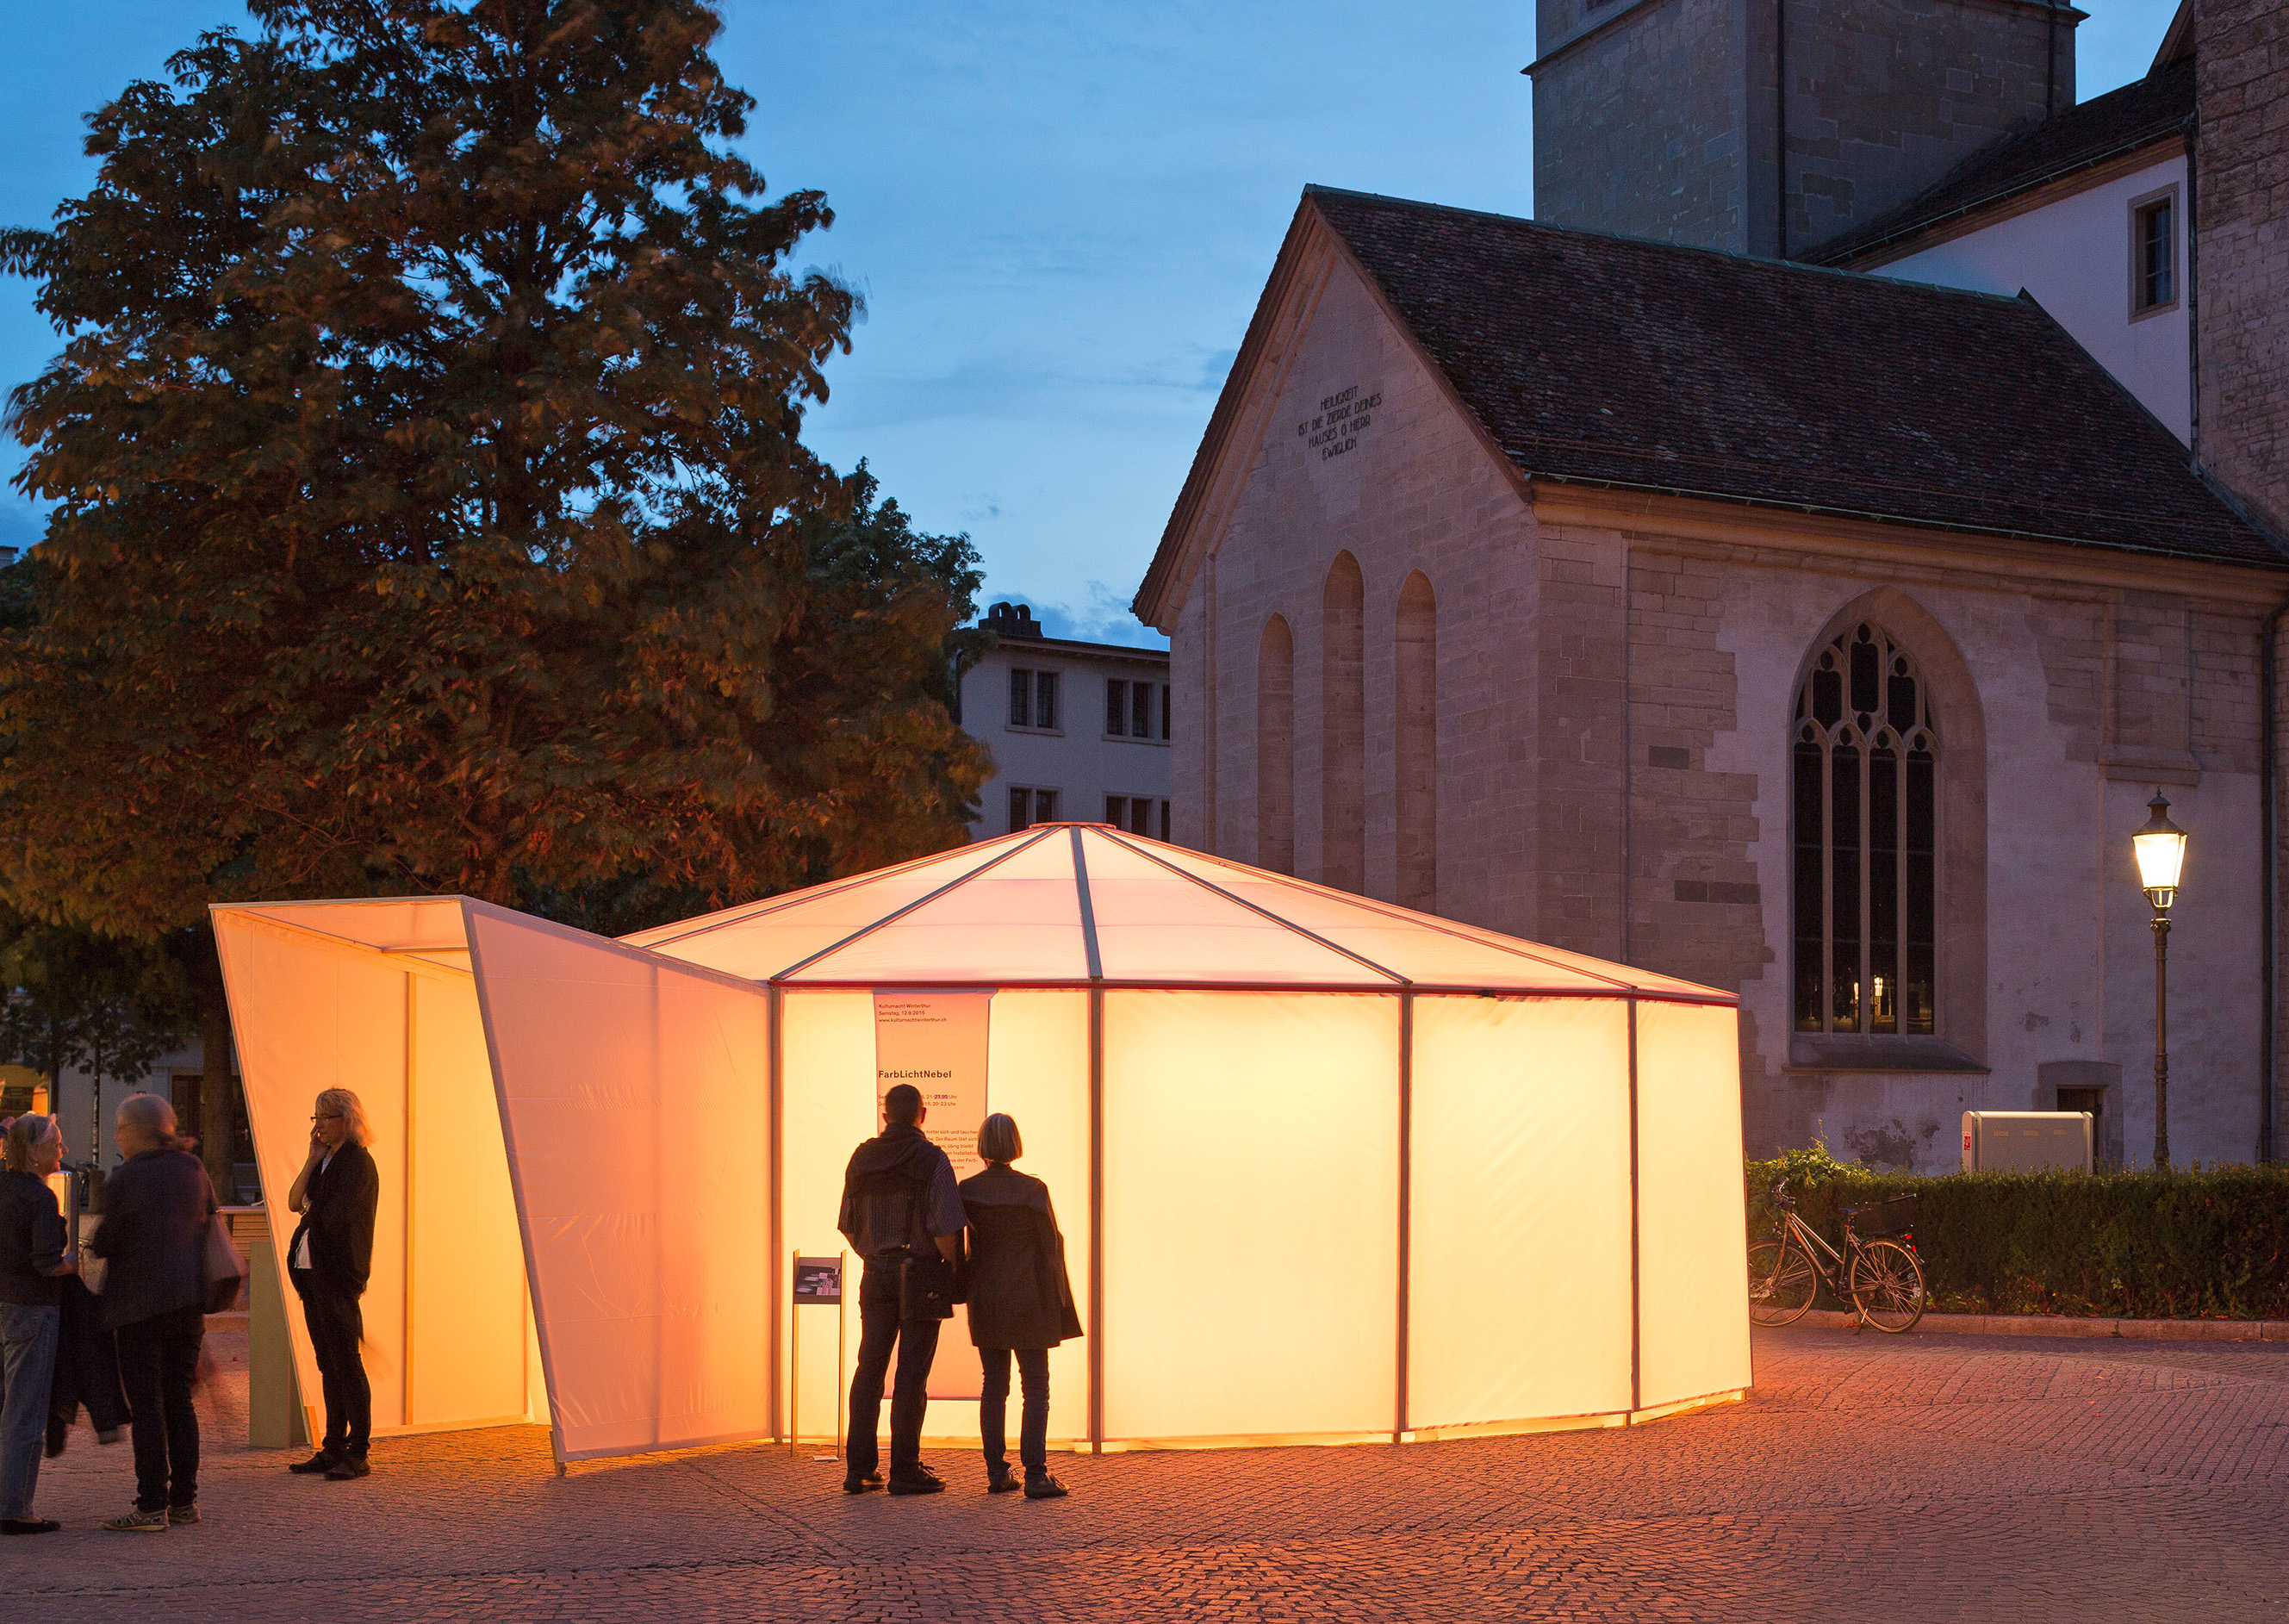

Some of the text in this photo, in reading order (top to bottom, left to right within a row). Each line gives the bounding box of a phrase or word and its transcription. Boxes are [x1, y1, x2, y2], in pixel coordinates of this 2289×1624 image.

[1321, 385, 1359, 412] HEILIGKEIT
[1298, 393, 1382, 437] IST DIE ZIERDE DEINES
[1309, 414, 1371, 449] HAUSES O HERR
[1322, 437, 1357, 461] EWIGLICH
